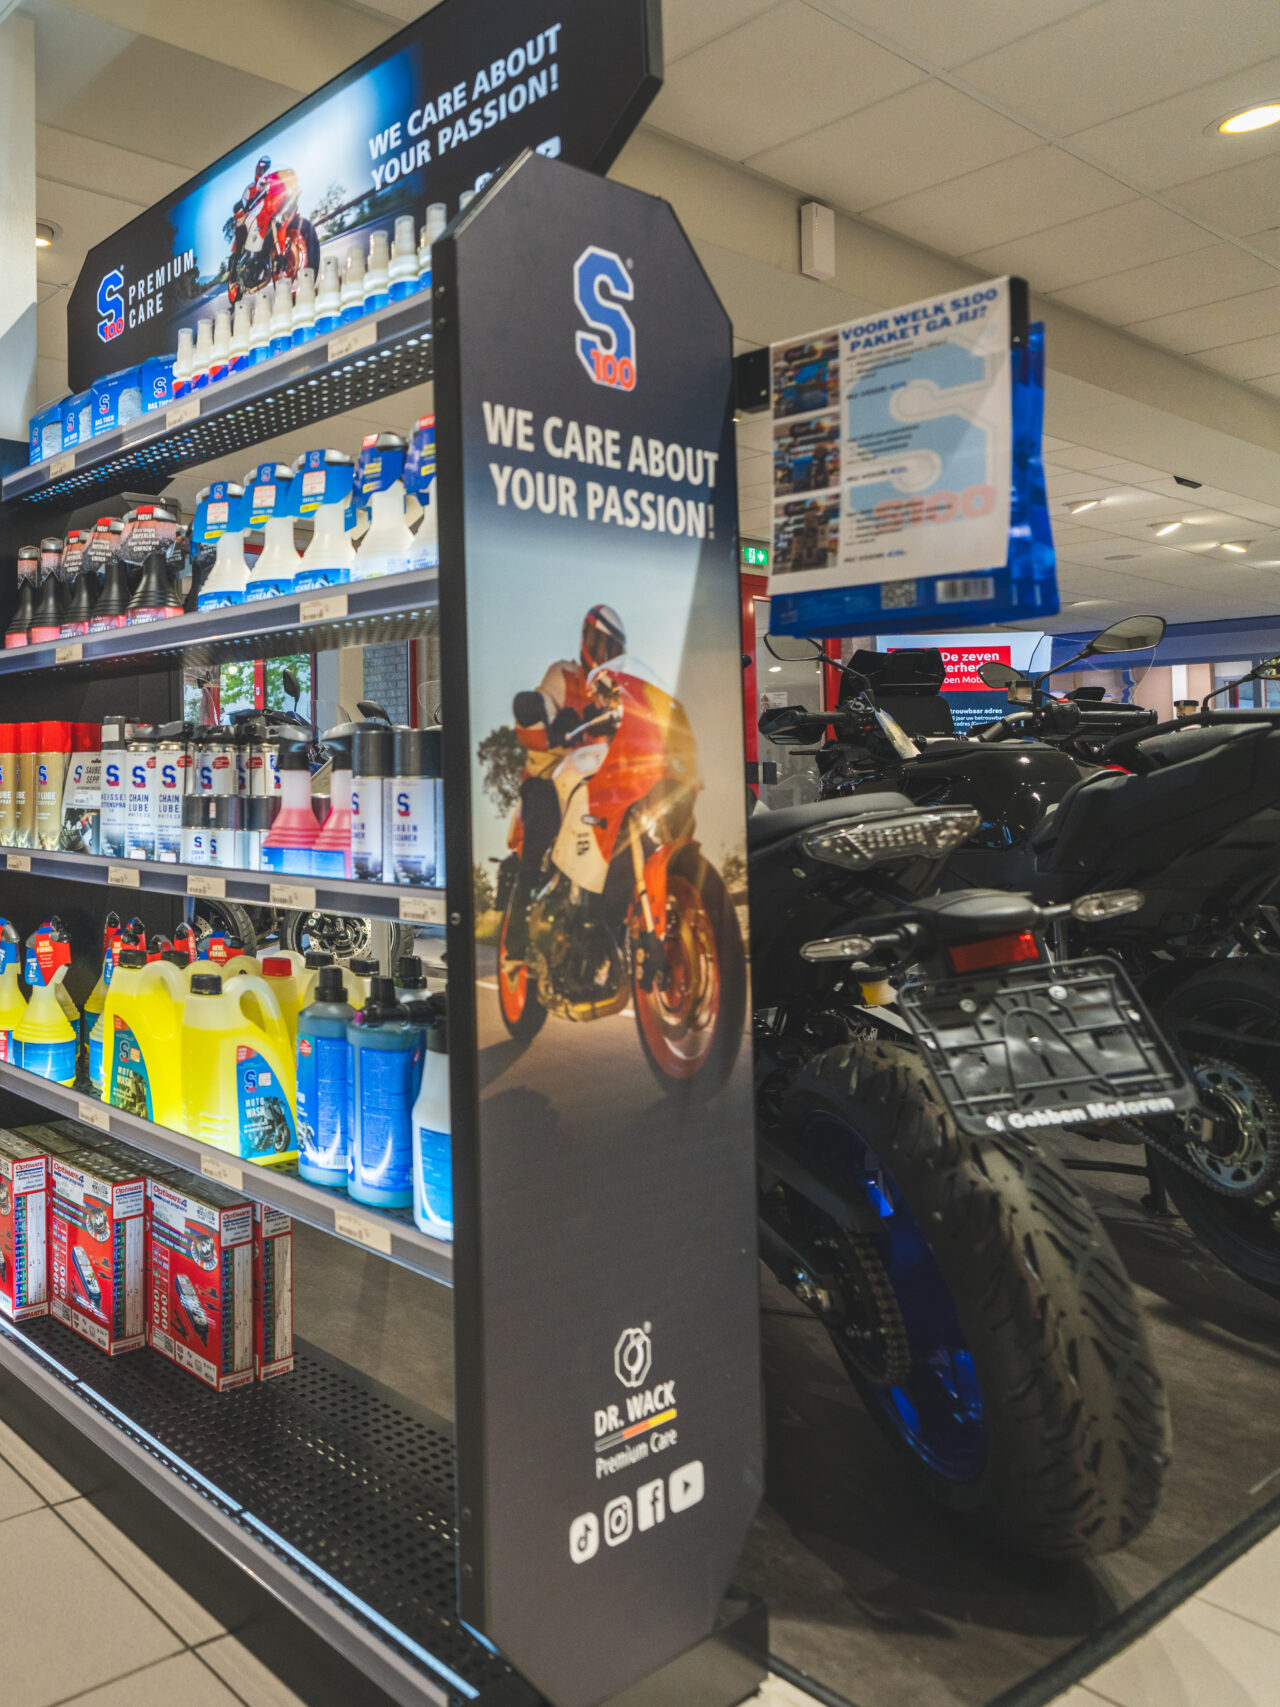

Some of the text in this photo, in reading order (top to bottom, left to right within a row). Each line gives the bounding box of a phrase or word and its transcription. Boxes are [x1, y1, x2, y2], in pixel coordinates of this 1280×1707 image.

[368, 22, 562, 160] WE CARE ABOUT
[370, 63, 559, 191] YOUR PASSION!
[128, 248, 194, 305] PREMIUM
[97, 268, 125, 343] S
[128, 292, 164, 328] CARE
[573, 245, 636, 391] S
[840, 288, 999, 342] VOOR WELK S100
[104, 318, 125, 341] 100
[849, 325, 923, 352] PAKKET
[925, 314, 955, 333] GA
[590, 348, 637, 391] 100
[481, 400, 720, 488] WE CARE ABOUT
[137, 513, 152, 521] NEU!
[488, 462, 716, 540] YOUR PASSION!
[941, 652, 1000, 661] De zeven
[129, 794, 149, 802] CHAIN
[129, 804, 149, 812] LUBE
[158, 794, 180, 803] CHAIN
[158, 804, 180, 813] LUBE
[245, 1097, 265, 1107] MOTO
[245, 1106, 265, 1118] WASH
[1008, 1096, 1176, 1129] Gebben Motoren
[594, 1379, 677, 1438] DR. WACK
[595, 1428, 678, 1480] Premium Care
